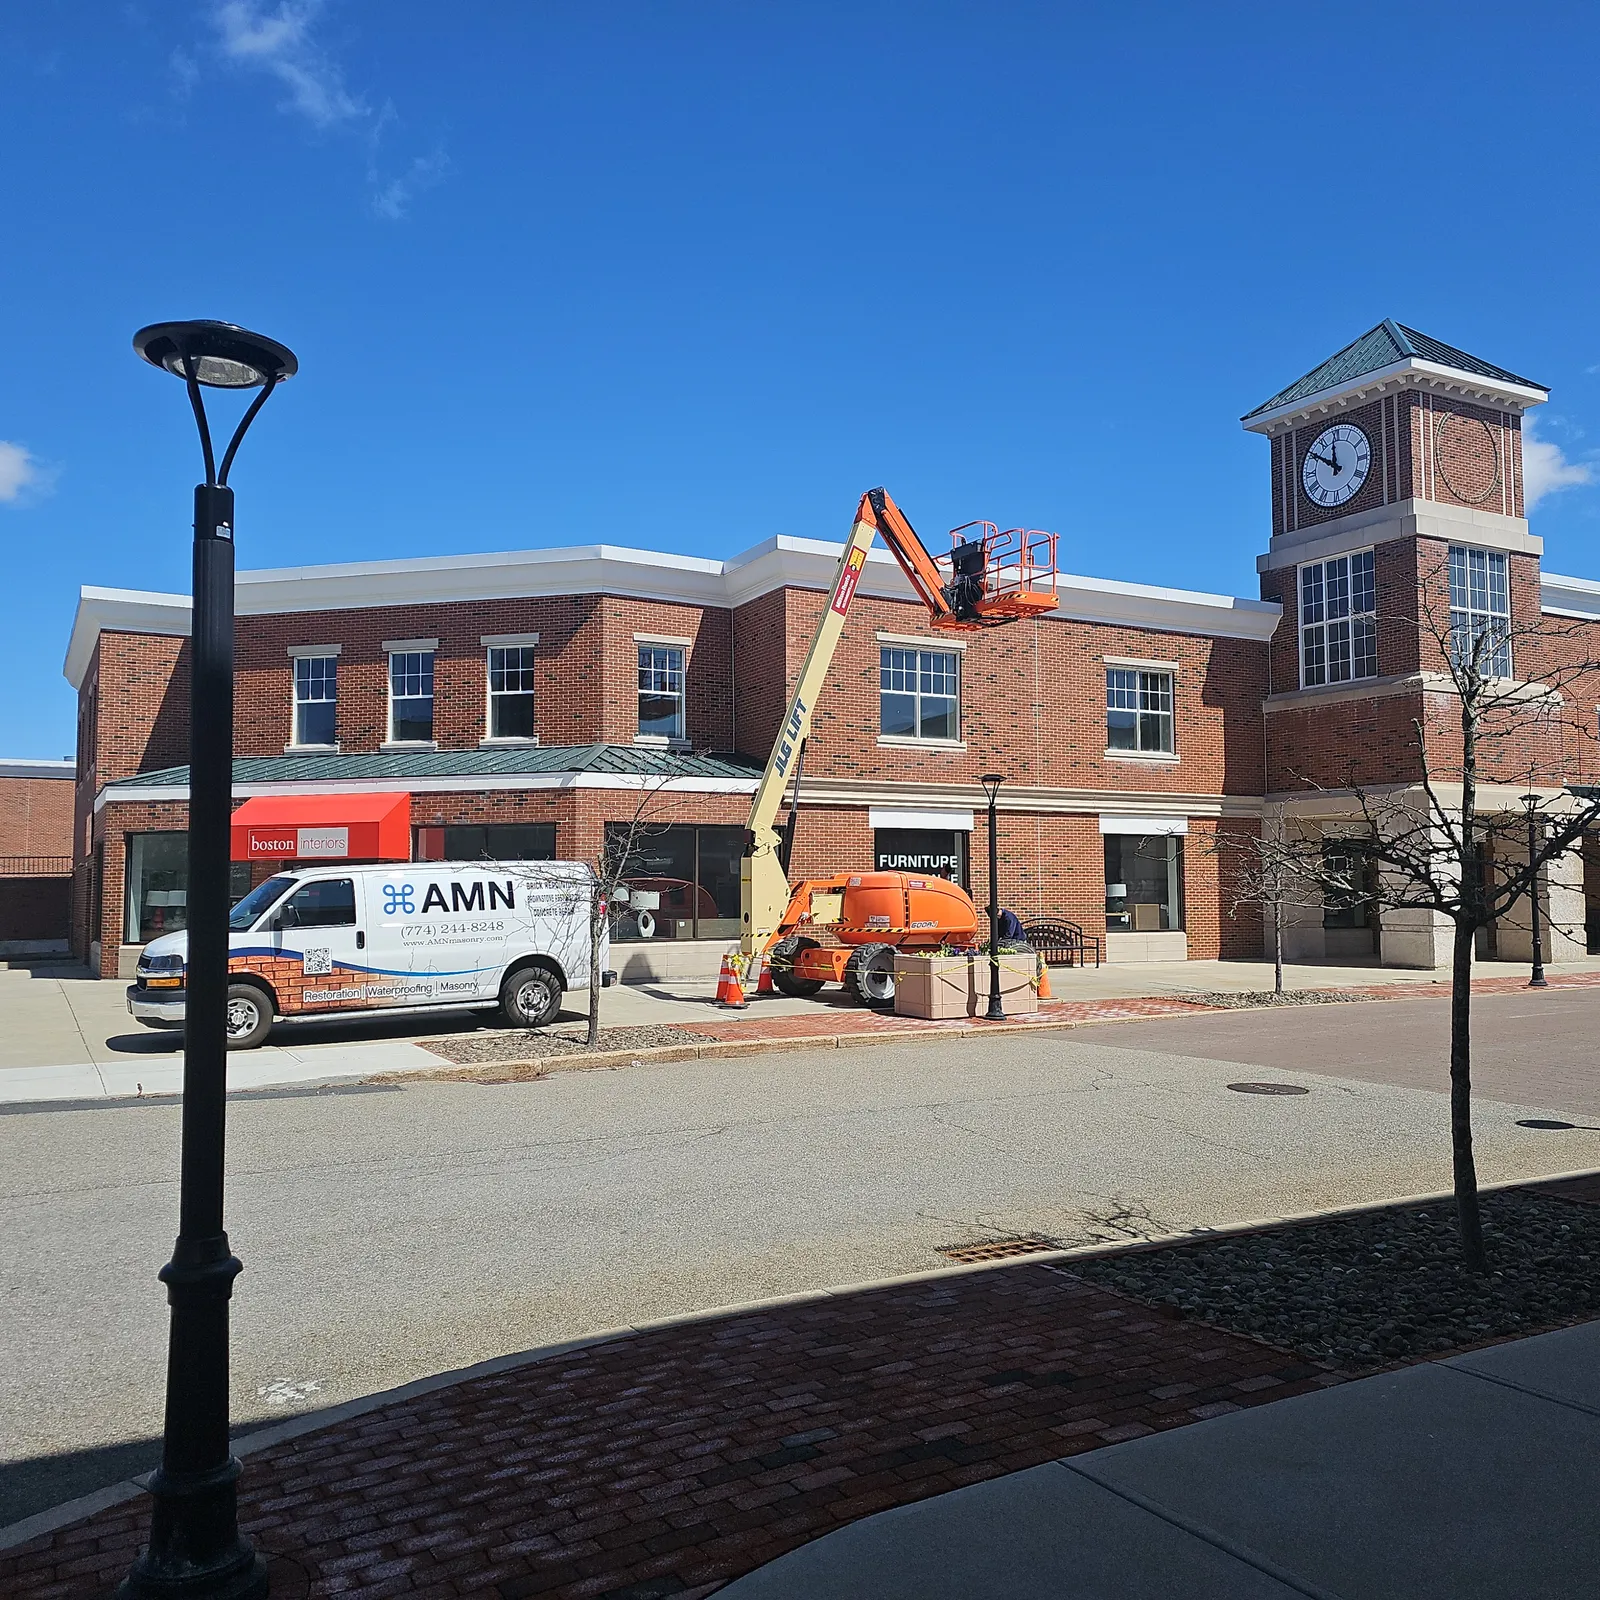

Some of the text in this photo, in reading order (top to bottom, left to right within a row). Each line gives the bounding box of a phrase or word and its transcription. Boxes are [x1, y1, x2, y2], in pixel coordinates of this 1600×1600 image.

[774, 697, 808, 778] JLG LIFT
[251, 835, 295, 851] boston
[300, 837, 346, 850] interiors
[879, 854, 958, 868] FURNITURE
[421, 880, 516, 914] AMN
[400, 920, 505, 940] (774) 244-8248
[403, 935, 503, 947] www.AMNmasonry.com
[304, 981, 479, 1001] Restoration Waterproofing Masonry
